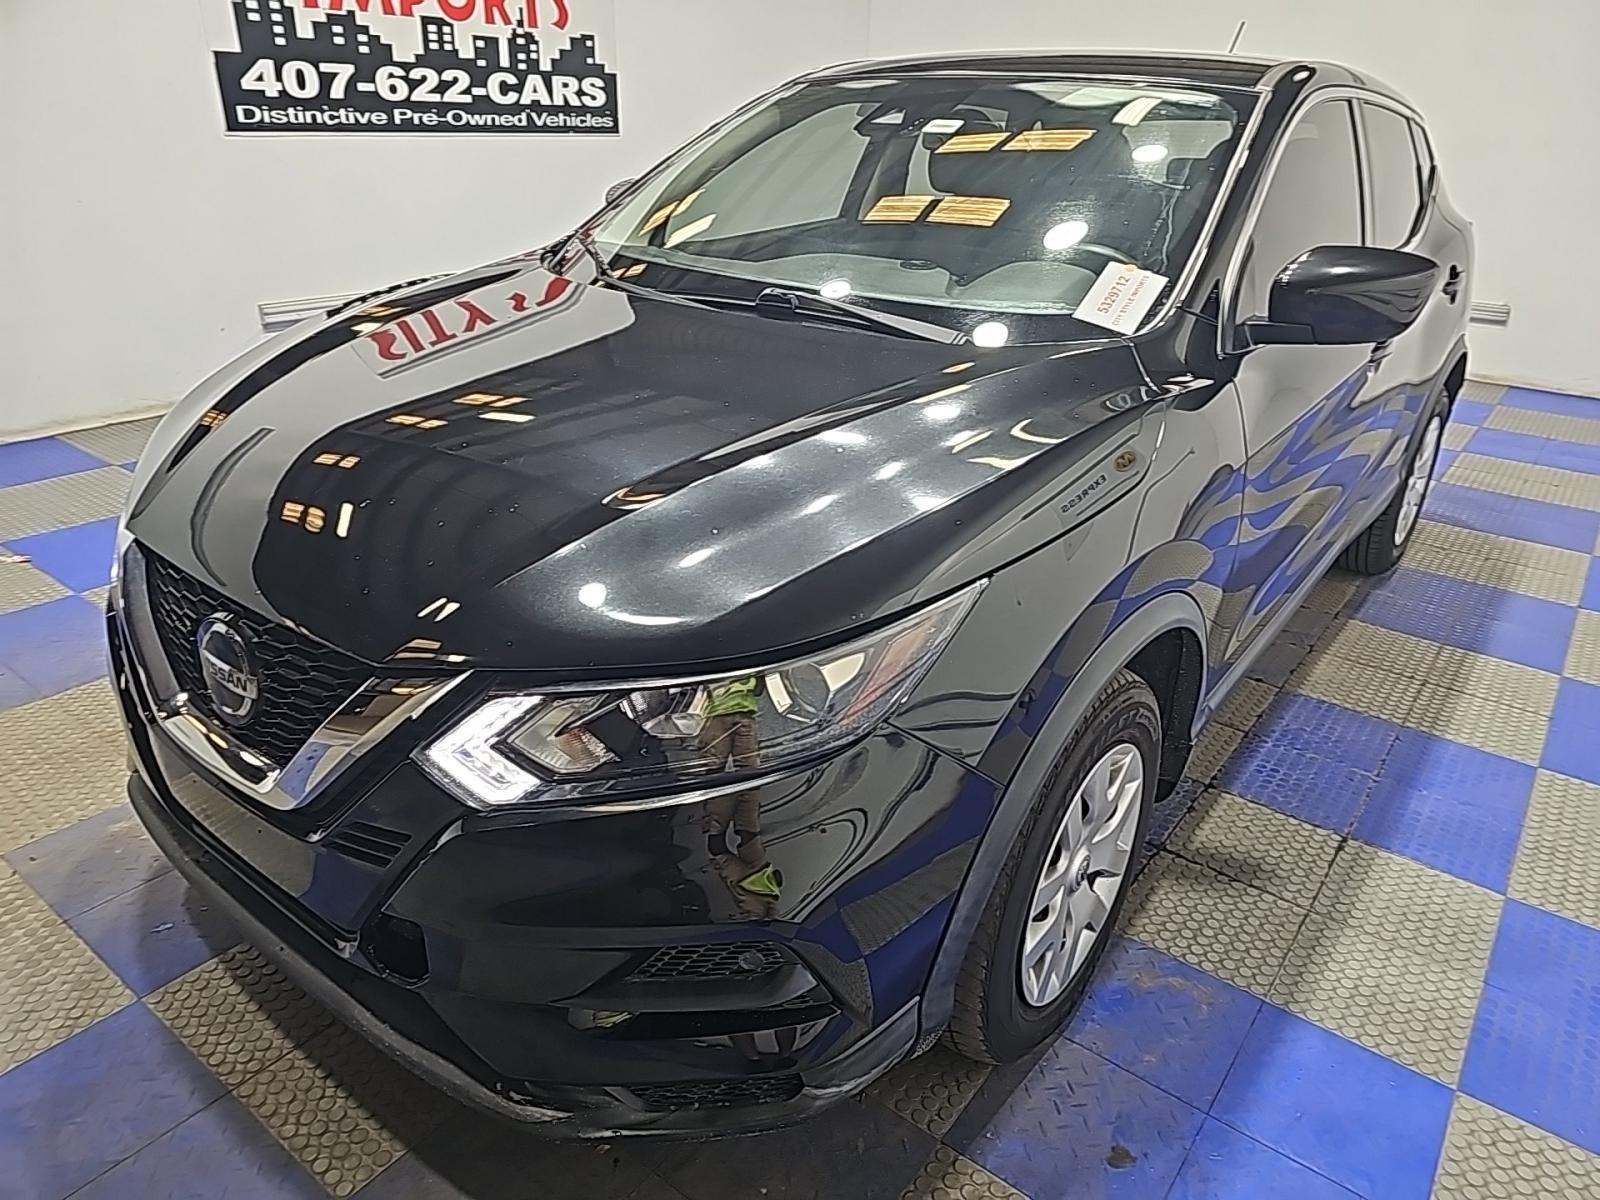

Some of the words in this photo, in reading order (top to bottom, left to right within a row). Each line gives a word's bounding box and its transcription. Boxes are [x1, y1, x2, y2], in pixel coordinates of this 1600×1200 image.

[300, 0, 569, 30] ORTS
[240, 58, 606, 107] 407-622-CARS
[236, 105, 388, 125] Distinctive
[395, 107, 527, 127] Pre-Owned
[528, 111, 614, 128] Vehicles
[1097, 275, 1130, 314] 5329712
[205, 656, 249, 692] SSAN
